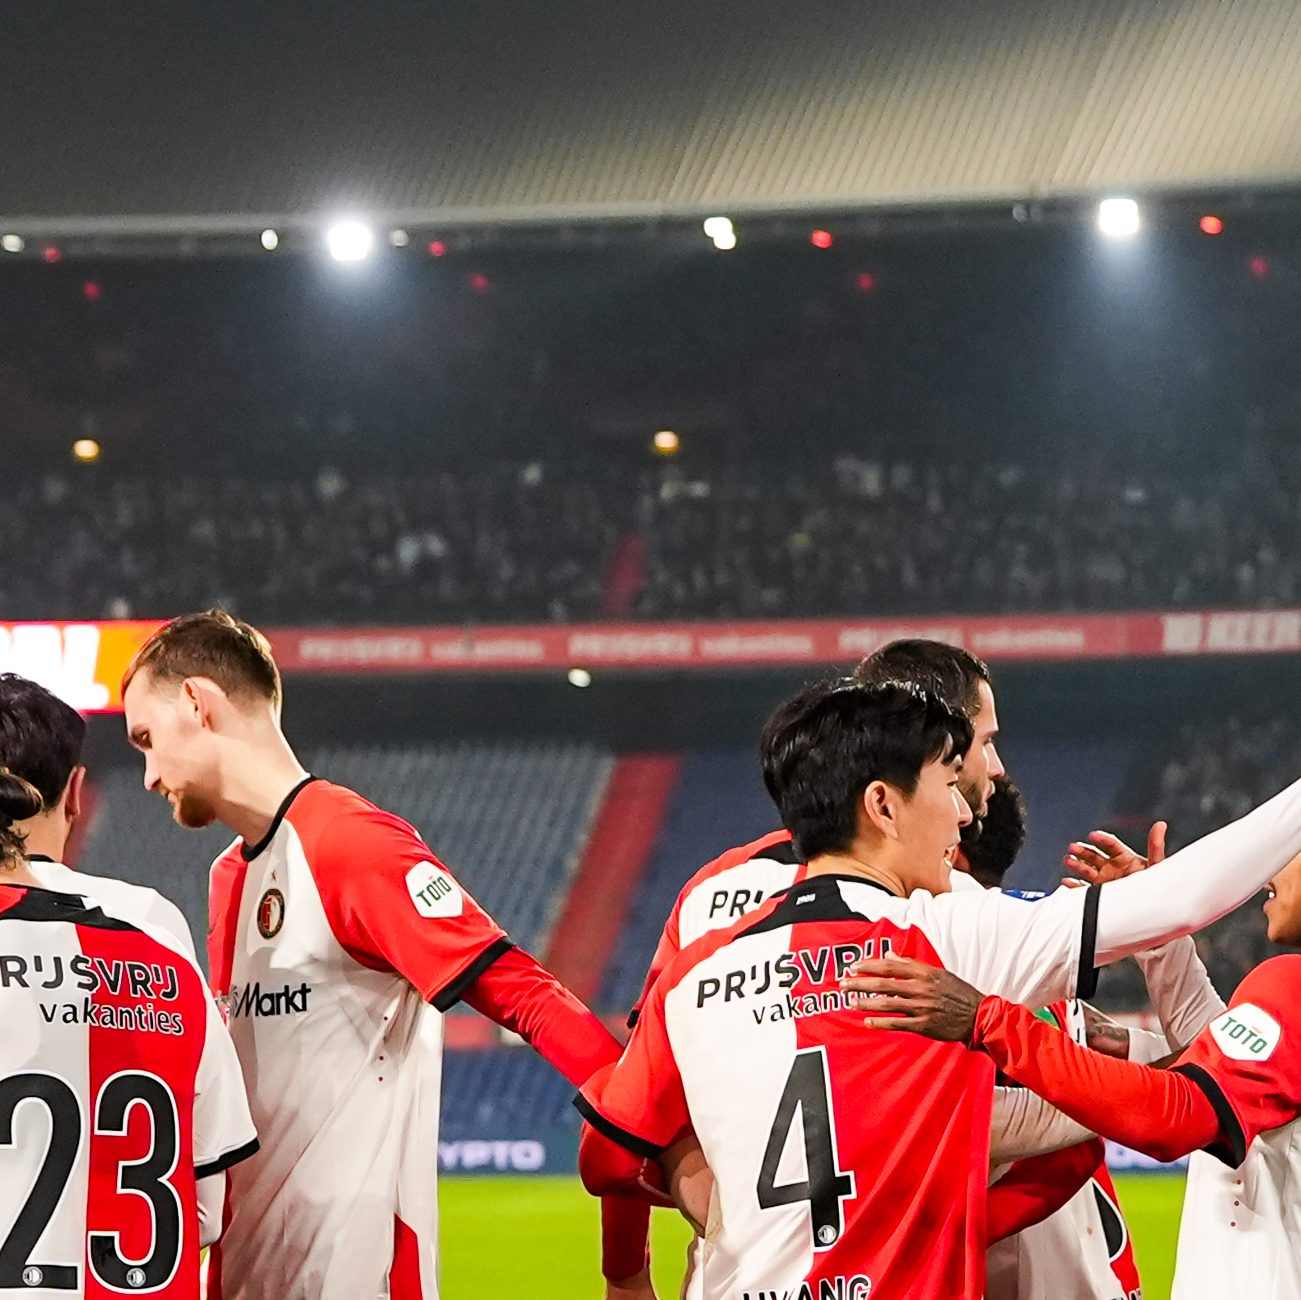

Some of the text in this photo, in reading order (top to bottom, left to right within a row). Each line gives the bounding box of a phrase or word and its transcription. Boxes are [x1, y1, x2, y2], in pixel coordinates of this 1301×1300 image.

[416, 876, 451, 907] TOTO
[39, 996, 186, 1035] vakanties
[1220, 1016, 1268, 1054] TOTO
[437, 1140, 546, 1171] YPTO
[757, 1050, 854, 1249] 4
